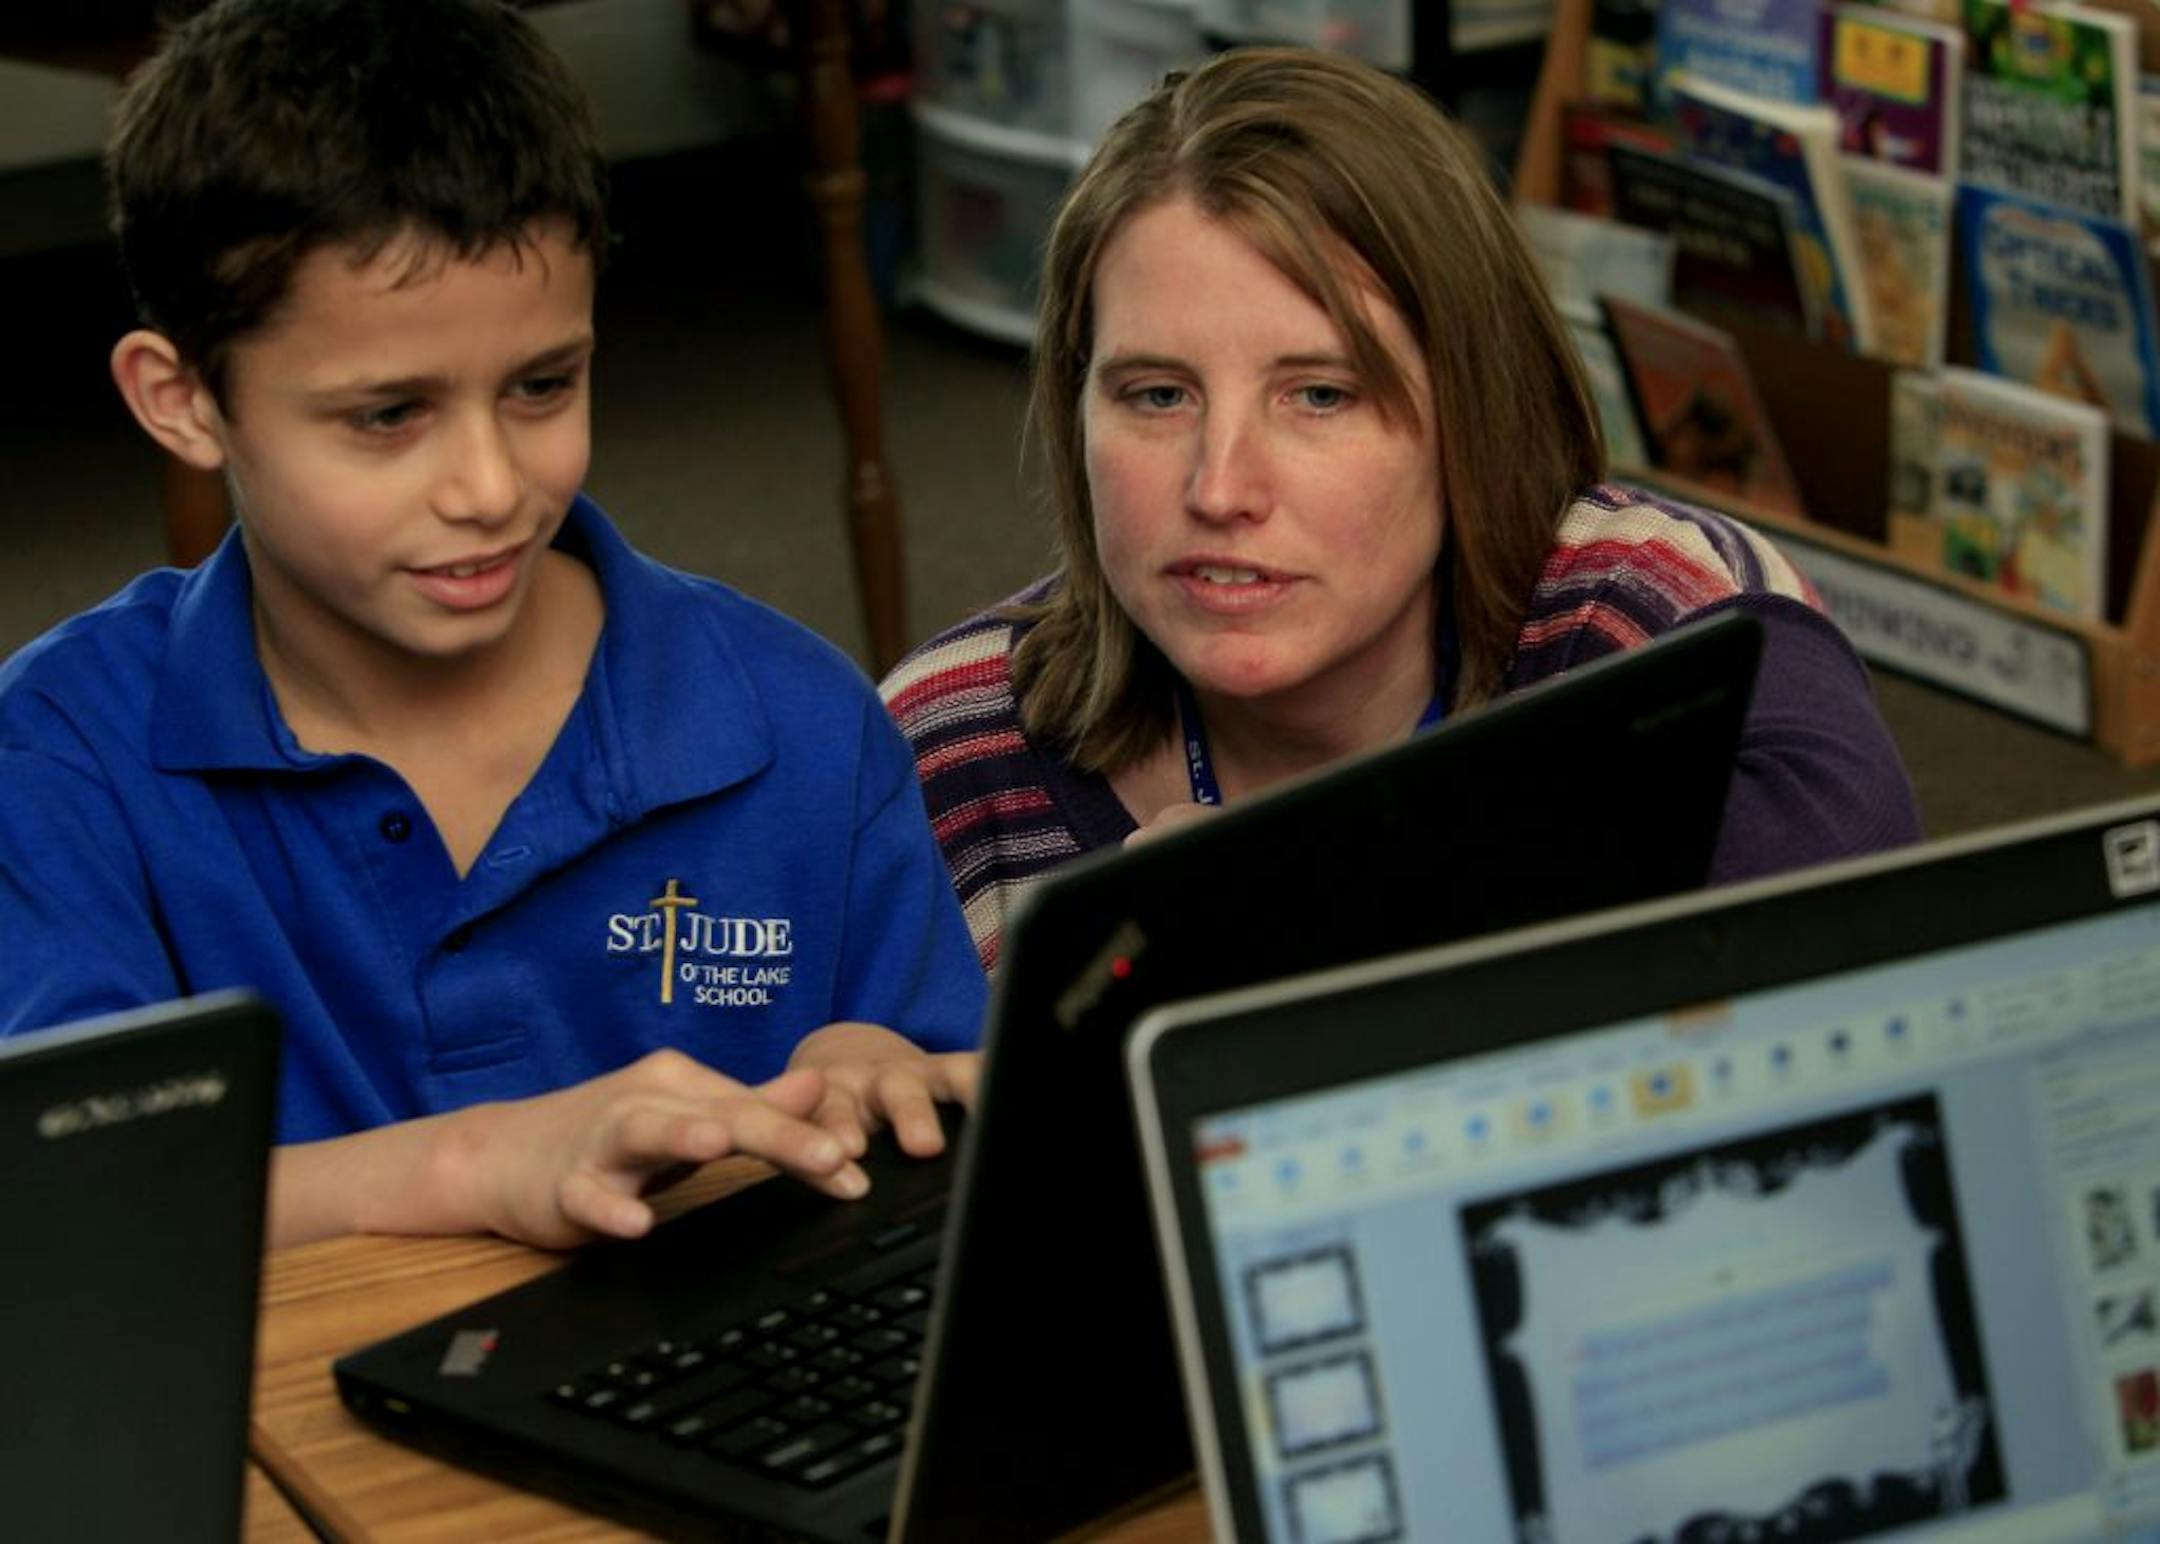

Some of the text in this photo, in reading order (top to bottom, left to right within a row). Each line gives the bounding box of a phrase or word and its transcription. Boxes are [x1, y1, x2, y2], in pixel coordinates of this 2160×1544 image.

[679, 912, 793, 957] JUDE
[701, 965, 740, 985] THE
[742, 966, 792, 986] LAKE
[694, 983, 774, 1007] SCHOOL
